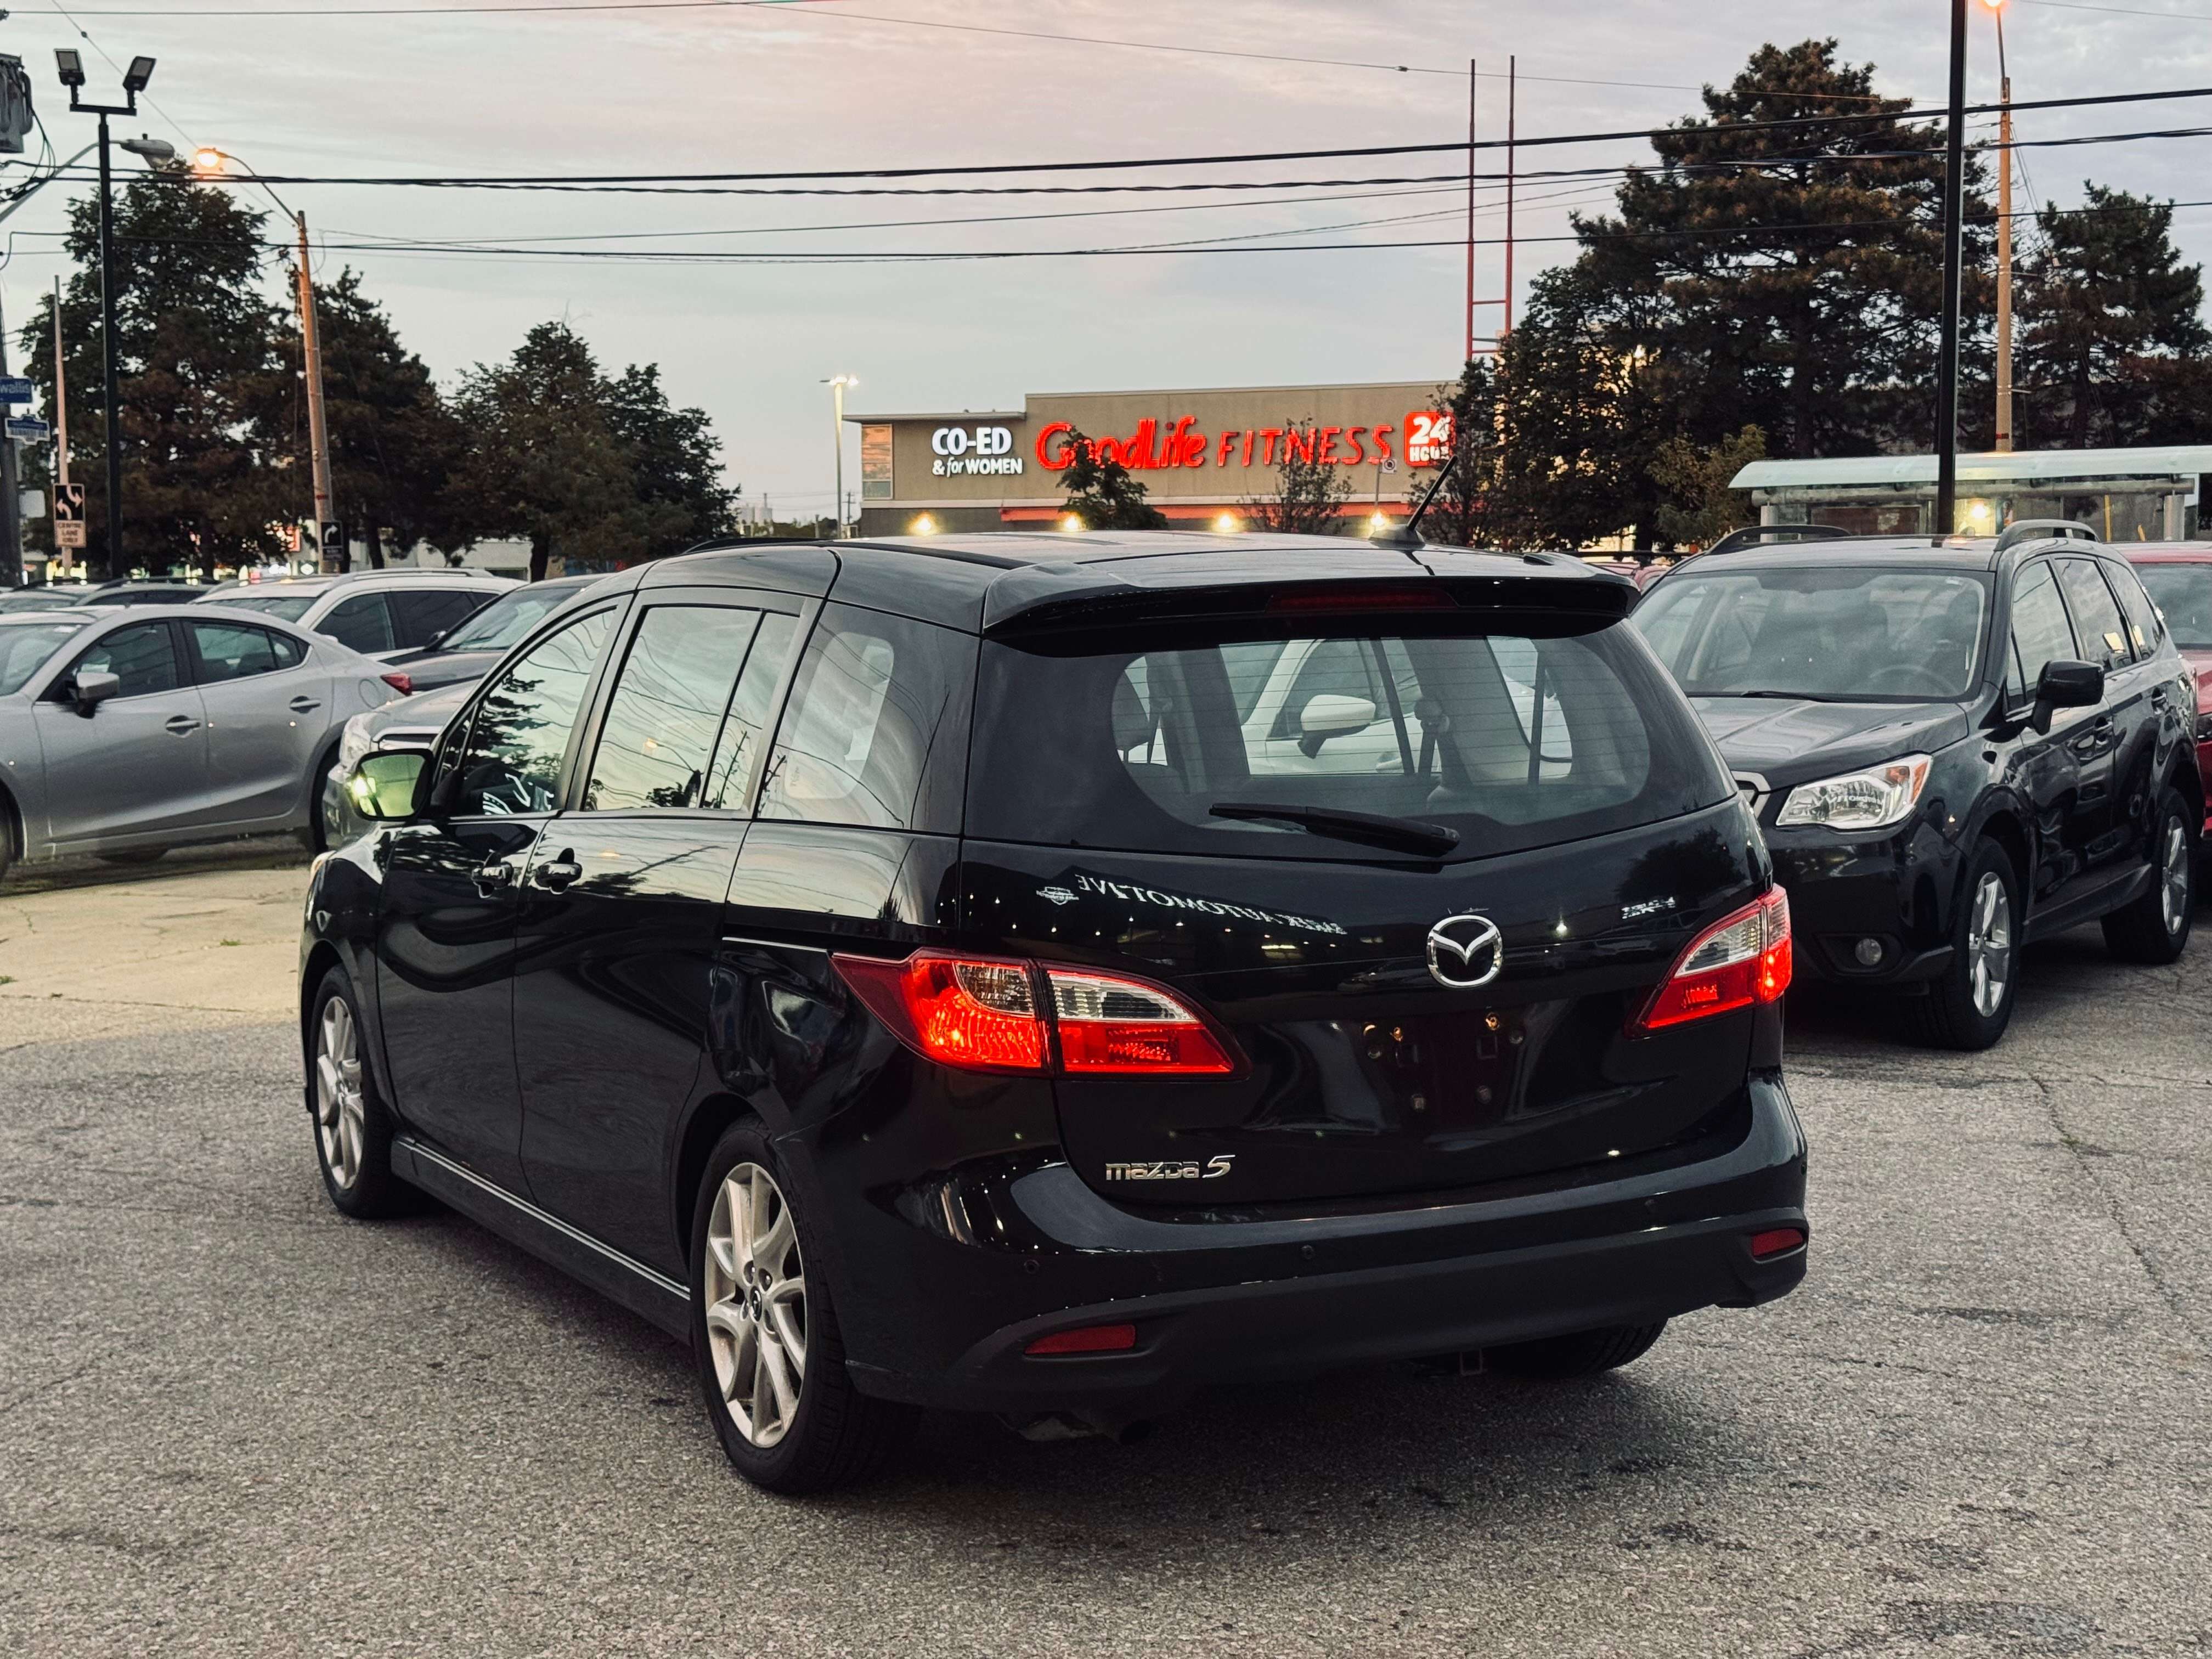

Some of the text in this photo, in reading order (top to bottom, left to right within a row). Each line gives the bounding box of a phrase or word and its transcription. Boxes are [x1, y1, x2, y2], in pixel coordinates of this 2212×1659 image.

[932, 427, 1013, 455] CO-ED
[1409, 416, 1452, 444] 24
[1217, 425, 1393, 466] FITNESS
[932, 457, 1023, 477] & for WOMEN
[1202, 1154, 1236, 1178] 5
